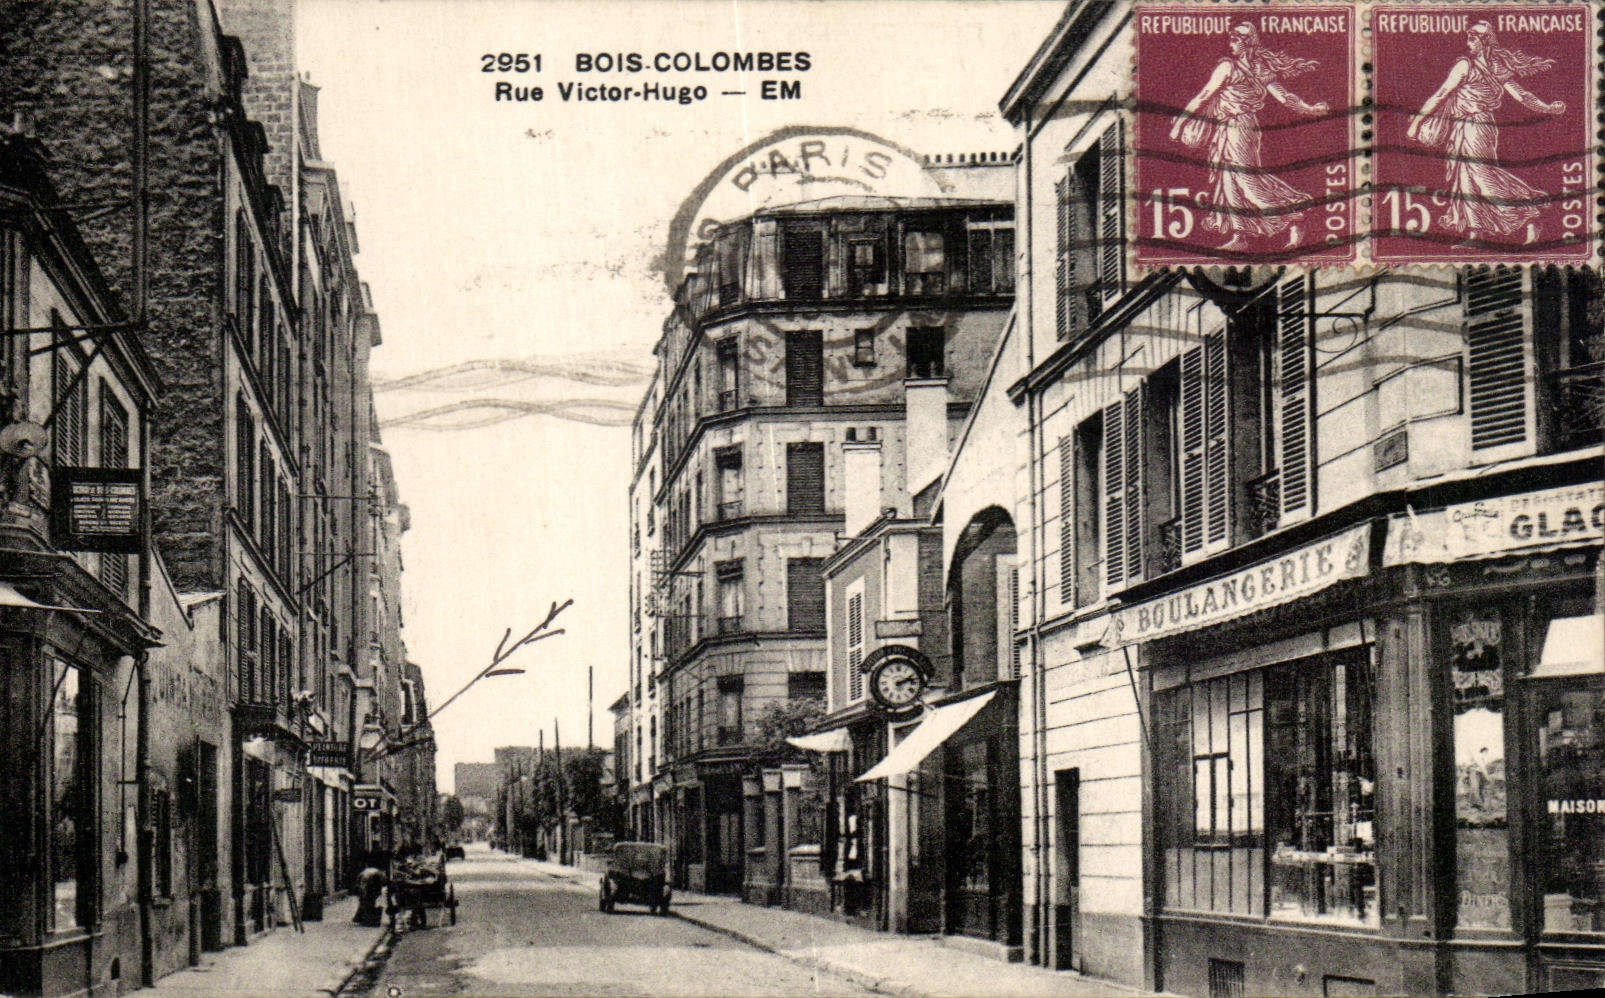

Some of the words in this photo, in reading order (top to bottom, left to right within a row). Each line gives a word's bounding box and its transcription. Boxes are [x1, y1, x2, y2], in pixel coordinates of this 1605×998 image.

[1260, 14, 1347, 36] FRANÇAISE
[1497, 14, 1584, 35] FRANÇAISE
[731, 139, 893, 192] PARIS
[1325, 162, 1346, 244] POSTES
[1137, 543, 1334, 633] BOULANGERIE
[1547, 799, 1605, 814] MAISON
